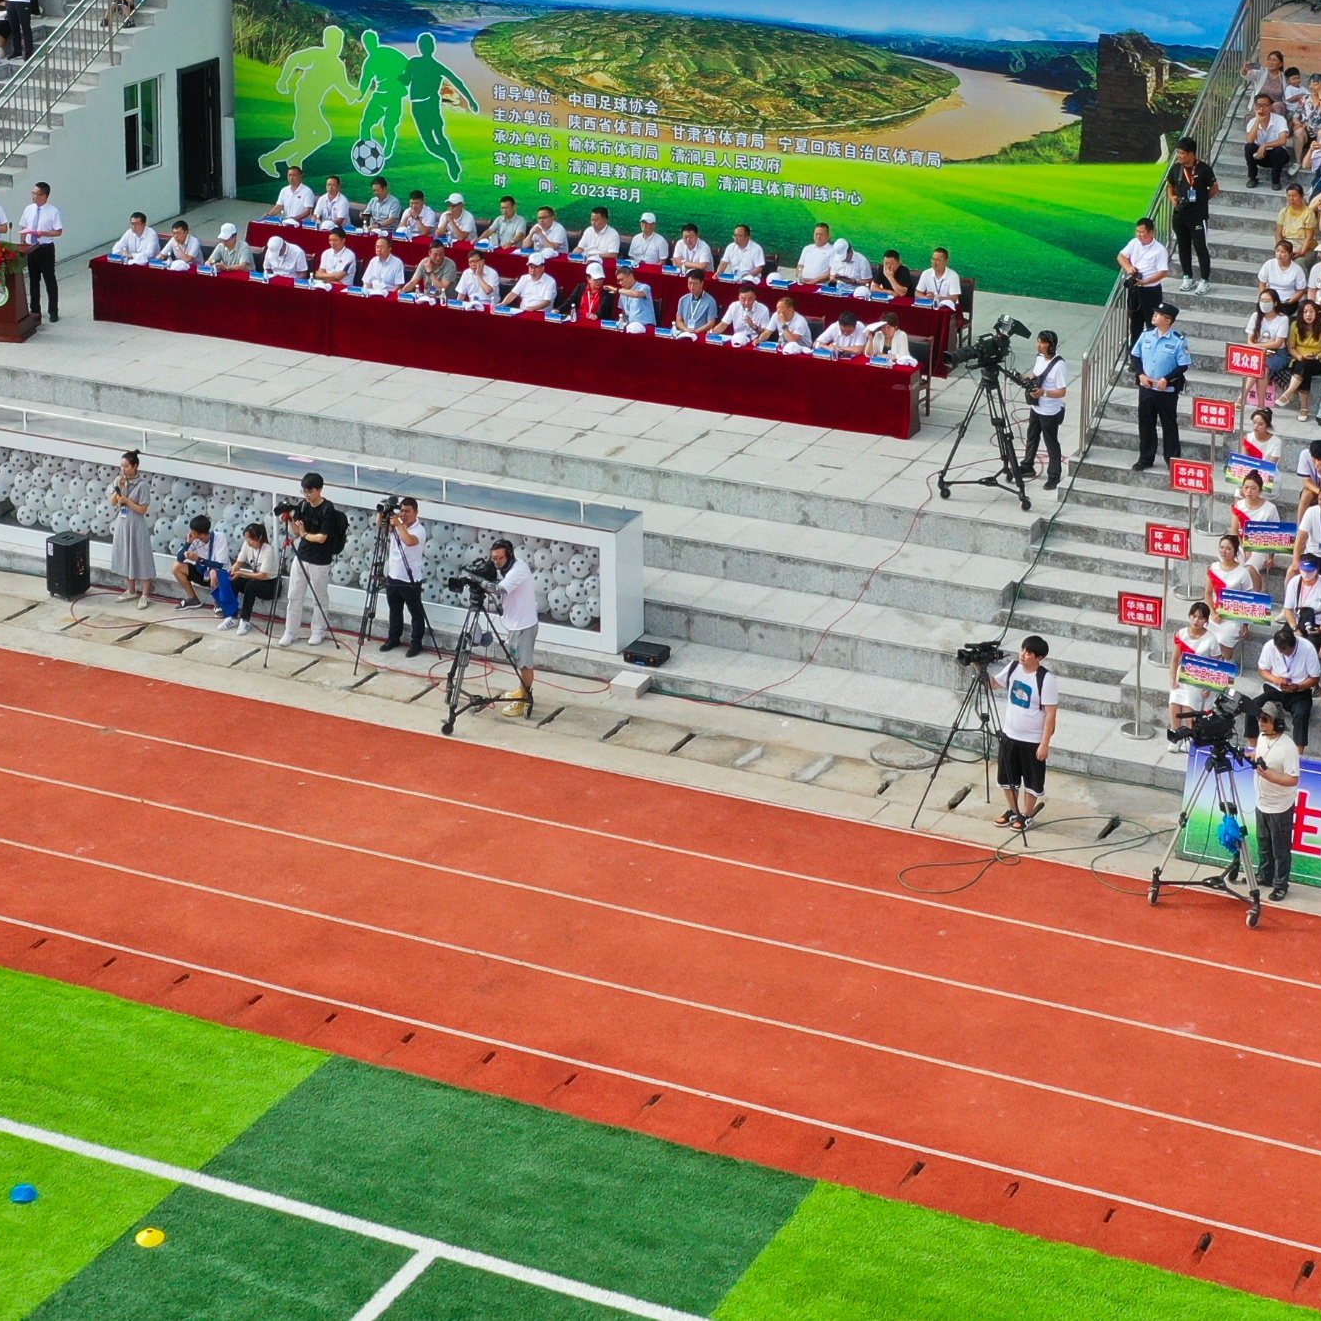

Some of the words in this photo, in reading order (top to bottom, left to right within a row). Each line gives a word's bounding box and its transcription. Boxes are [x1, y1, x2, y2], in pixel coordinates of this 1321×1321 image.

[672, 124, 766, 150] 甘肃省体育局
[778, 135, 942, 169] 宁夏回族自治区体育局
[671, 146, 781, 175] 清涧县人民政府
[717, 174, 864, 207] 清涧县体育训练中心
[1231, 351, 1260, 371] 观众席
[1200, 415, 1226, 426] 代表队
[1178, 467, 1204, 478] 志丹县
[1178, 477, 1204, 489] 代表队
[1154, 542, 1181, 554] 代表队
[1126, 600, 1155, 612] 华池县
[1126, 612, 1155, 623] 代表队
